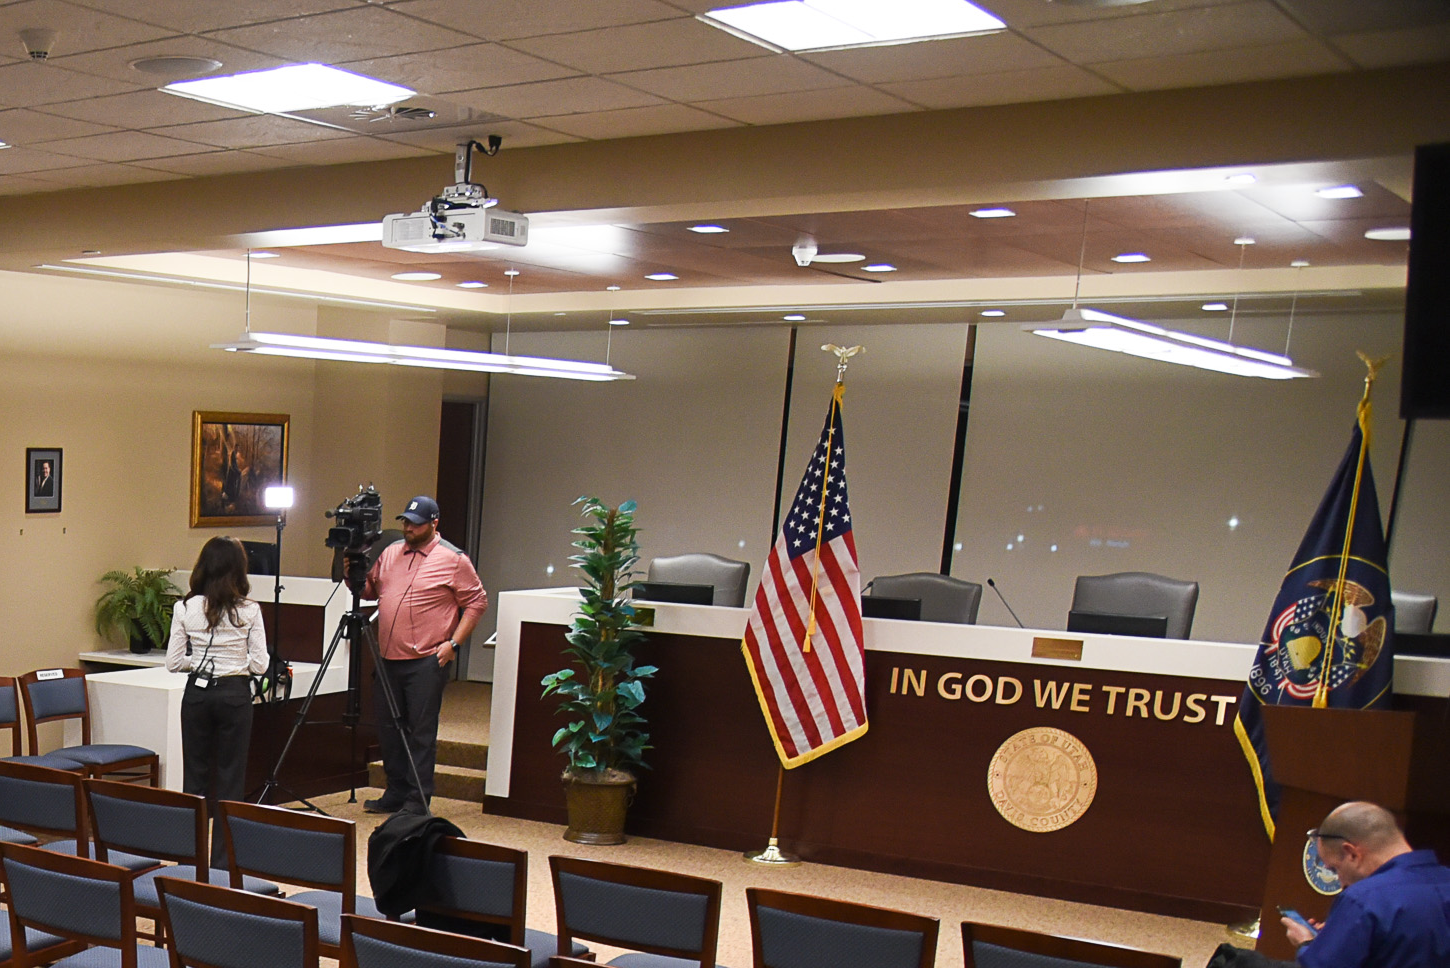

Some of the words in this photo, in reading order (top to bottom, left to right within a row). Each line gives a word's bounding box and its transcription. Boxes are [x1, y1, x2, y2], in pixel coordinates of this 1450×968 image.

[1267, 655, 1283, 680] 1847
[1279, 646, 1292, 675] UTAH
[889, 666, 928, 698] IN
[937, 671, 1023, 706] GOD
[1033, 679, 1093, 713] WE
[1101, 685, 1237, 726] TRUST
[1250, 663, 1272, 695] 1896
[999, 734, 1036, 763] STATE
[1040, 734, 1058, 745] OF
[1062, 739, 1089, 772] UTAH
[994, 790, 1025, 822] DAVIS
[1030, 799, 1083, 827] COUNTY
